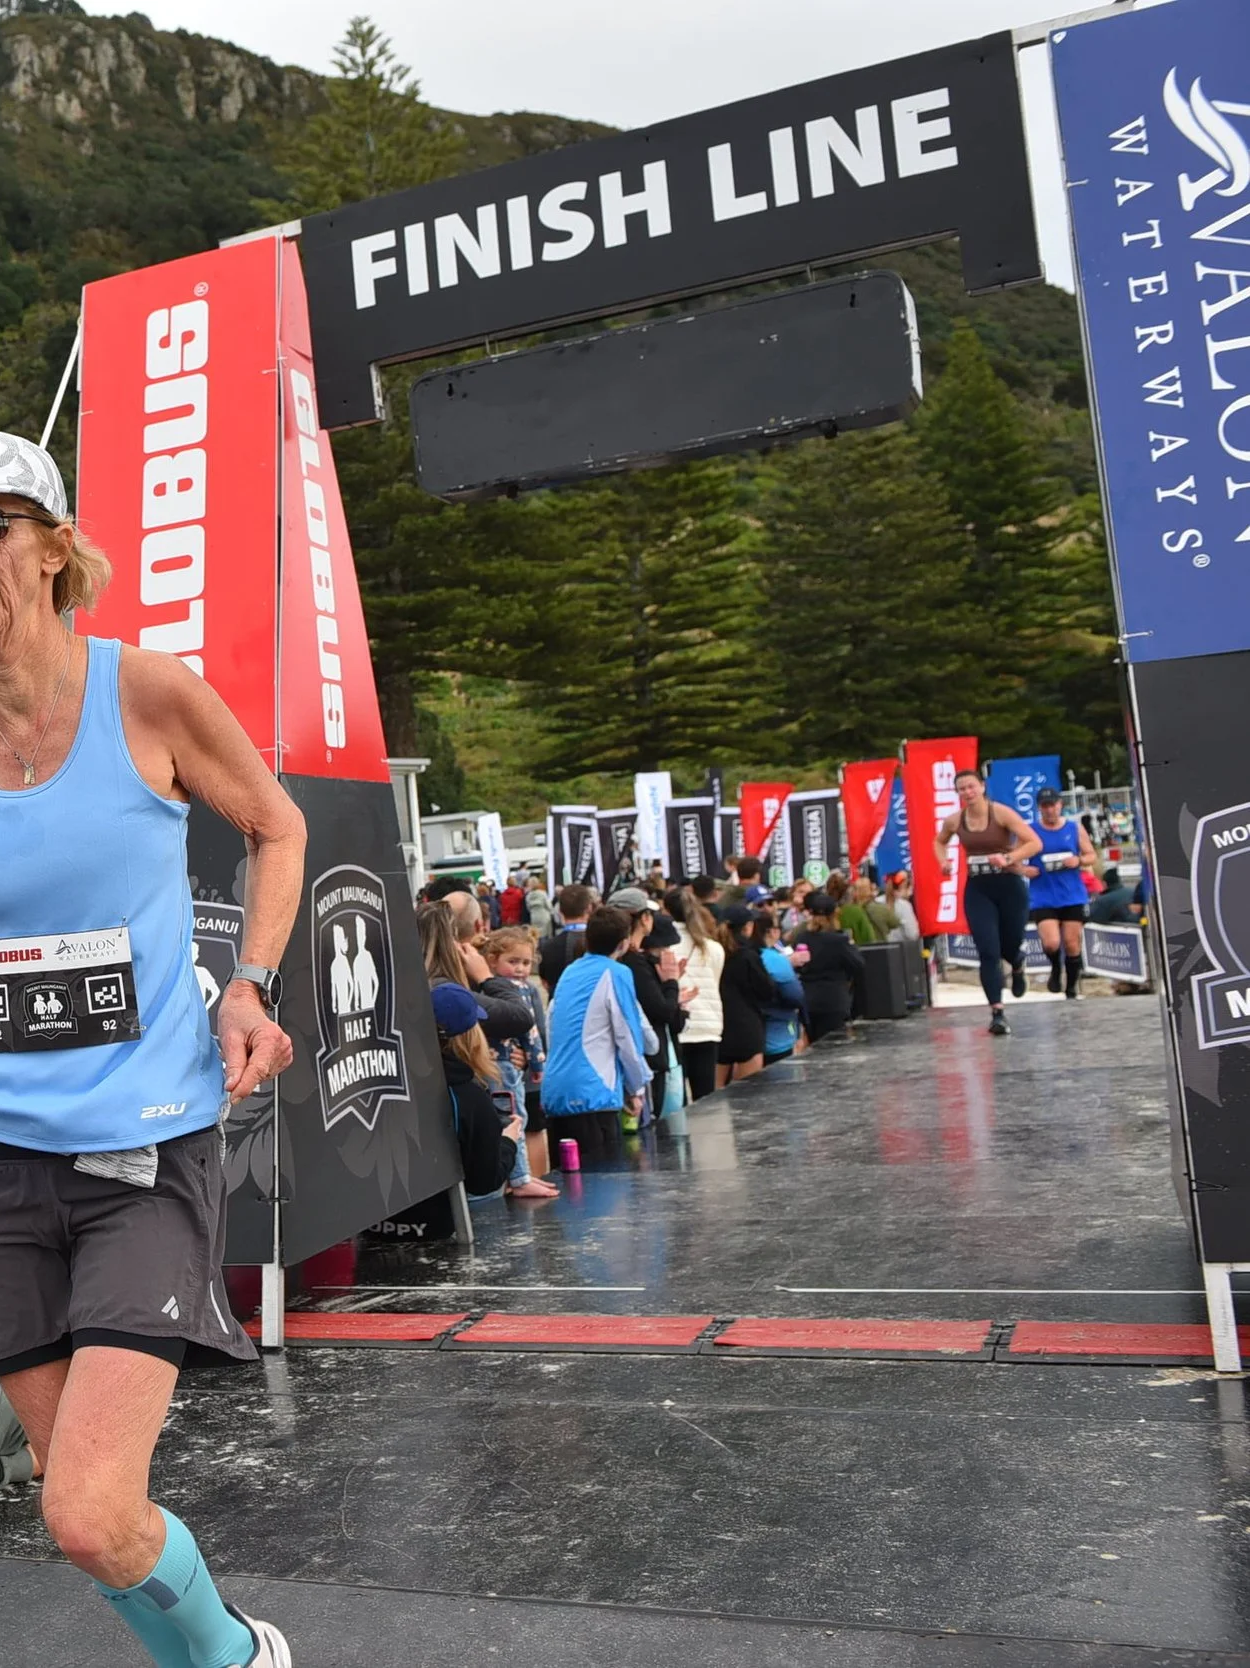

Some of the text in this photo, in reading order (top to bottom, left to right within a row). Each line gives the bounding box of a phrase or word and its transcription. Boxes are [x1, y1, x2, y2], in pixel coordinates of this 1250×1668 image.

[350, 86, 959, 311] FINISH LINE
[684, 818, 701, 873] MEDIA
[807, 809, 823, 859] MEDIA
[316, 885, 383, 919] MOUNT MAUNGANUI
[193, 916, 240, 935] GANUI
[54, 938, 116, 956] AVALON
[28, 1020, 73, 1032] MARATHON
[40, 1013, 57, 1021] HALF
[101, 1018, 117, 1031] 92
[344, 1016, 372, 1043] HALF
[326, 1048, 398, 1097] MARATHON
[140, 1102, 186, 1120] 2XU
